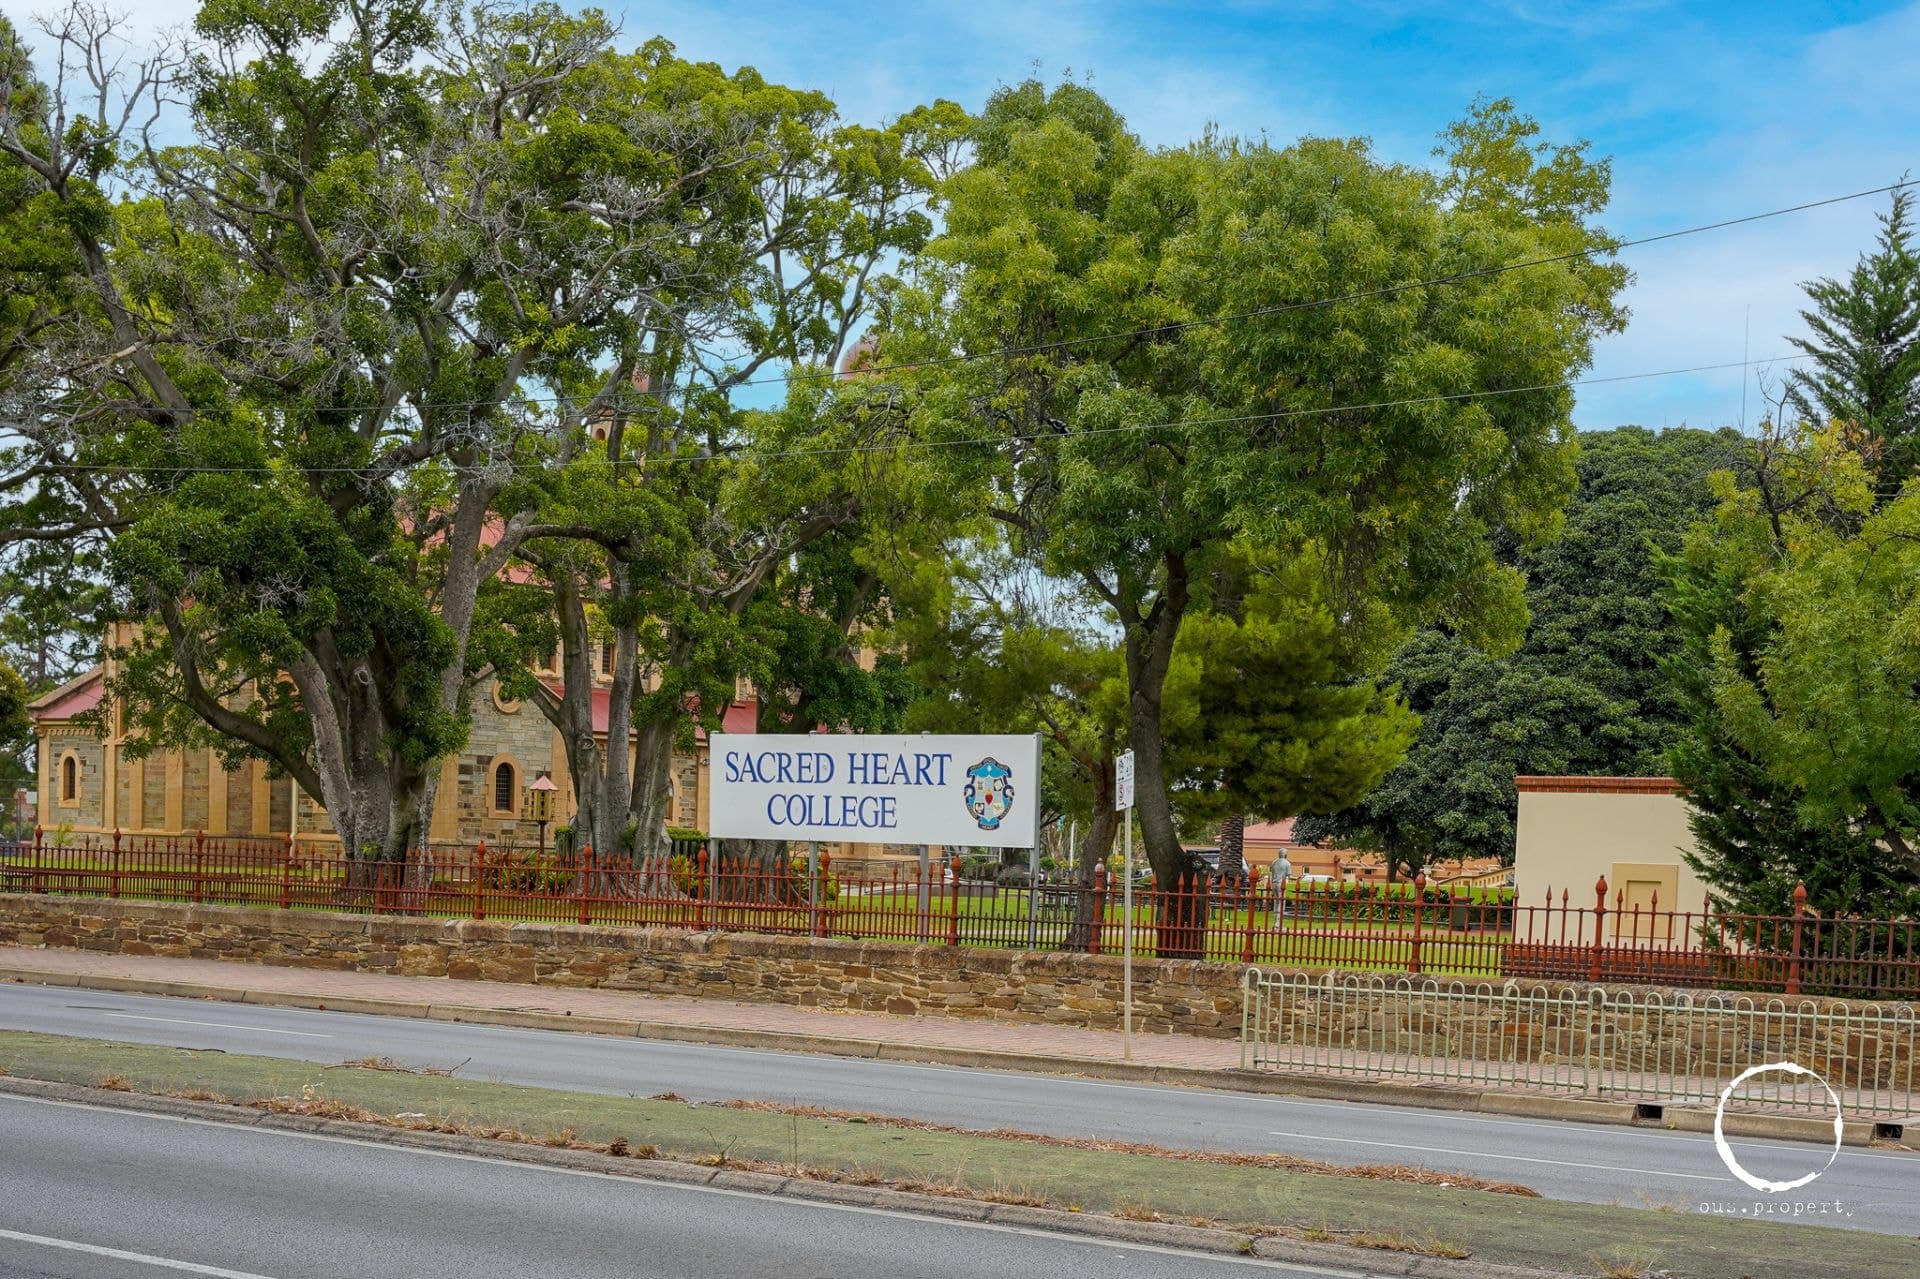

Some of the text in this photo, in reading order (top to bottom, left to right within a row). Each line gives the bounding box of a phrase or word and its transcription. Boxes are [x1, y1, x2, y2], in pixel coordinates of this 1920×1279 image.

[725, 751, 952, 786] SACRED HEART
[767, 794, 898, 828] COLLEGE
